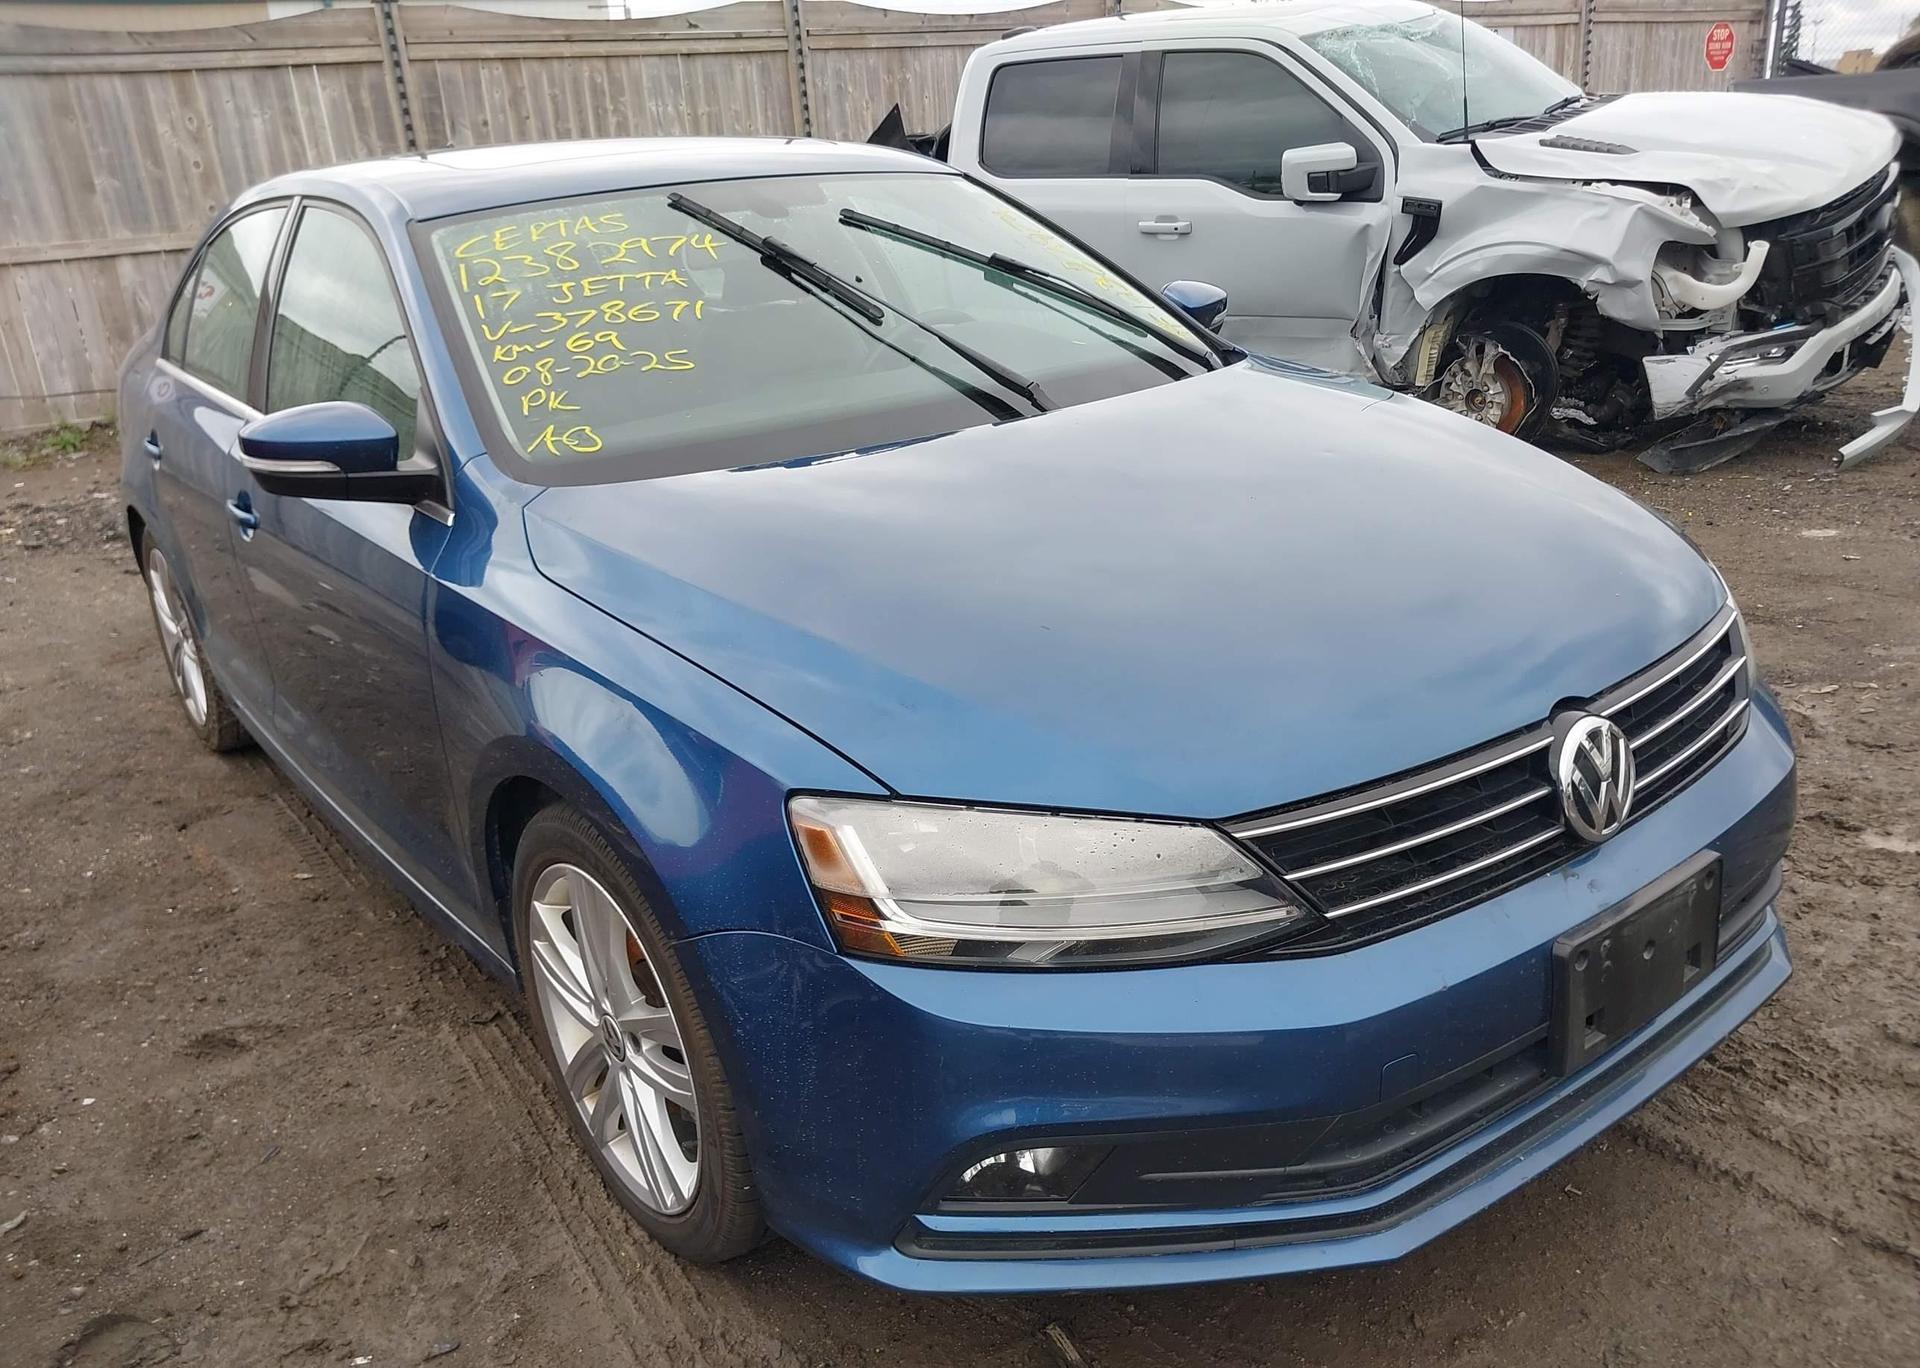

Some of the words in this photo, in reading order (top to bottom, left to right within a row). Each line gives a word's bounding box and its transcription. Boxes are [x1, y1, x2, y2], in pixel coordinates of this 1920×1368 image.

[1712, 28, 1730, 41] STOP
[474, 291, 522, 320] 17
[546, 270, 690, 304] JETTA
[521, 388, 582, 416] PK
[1558, 714, 1636, 842] VW
